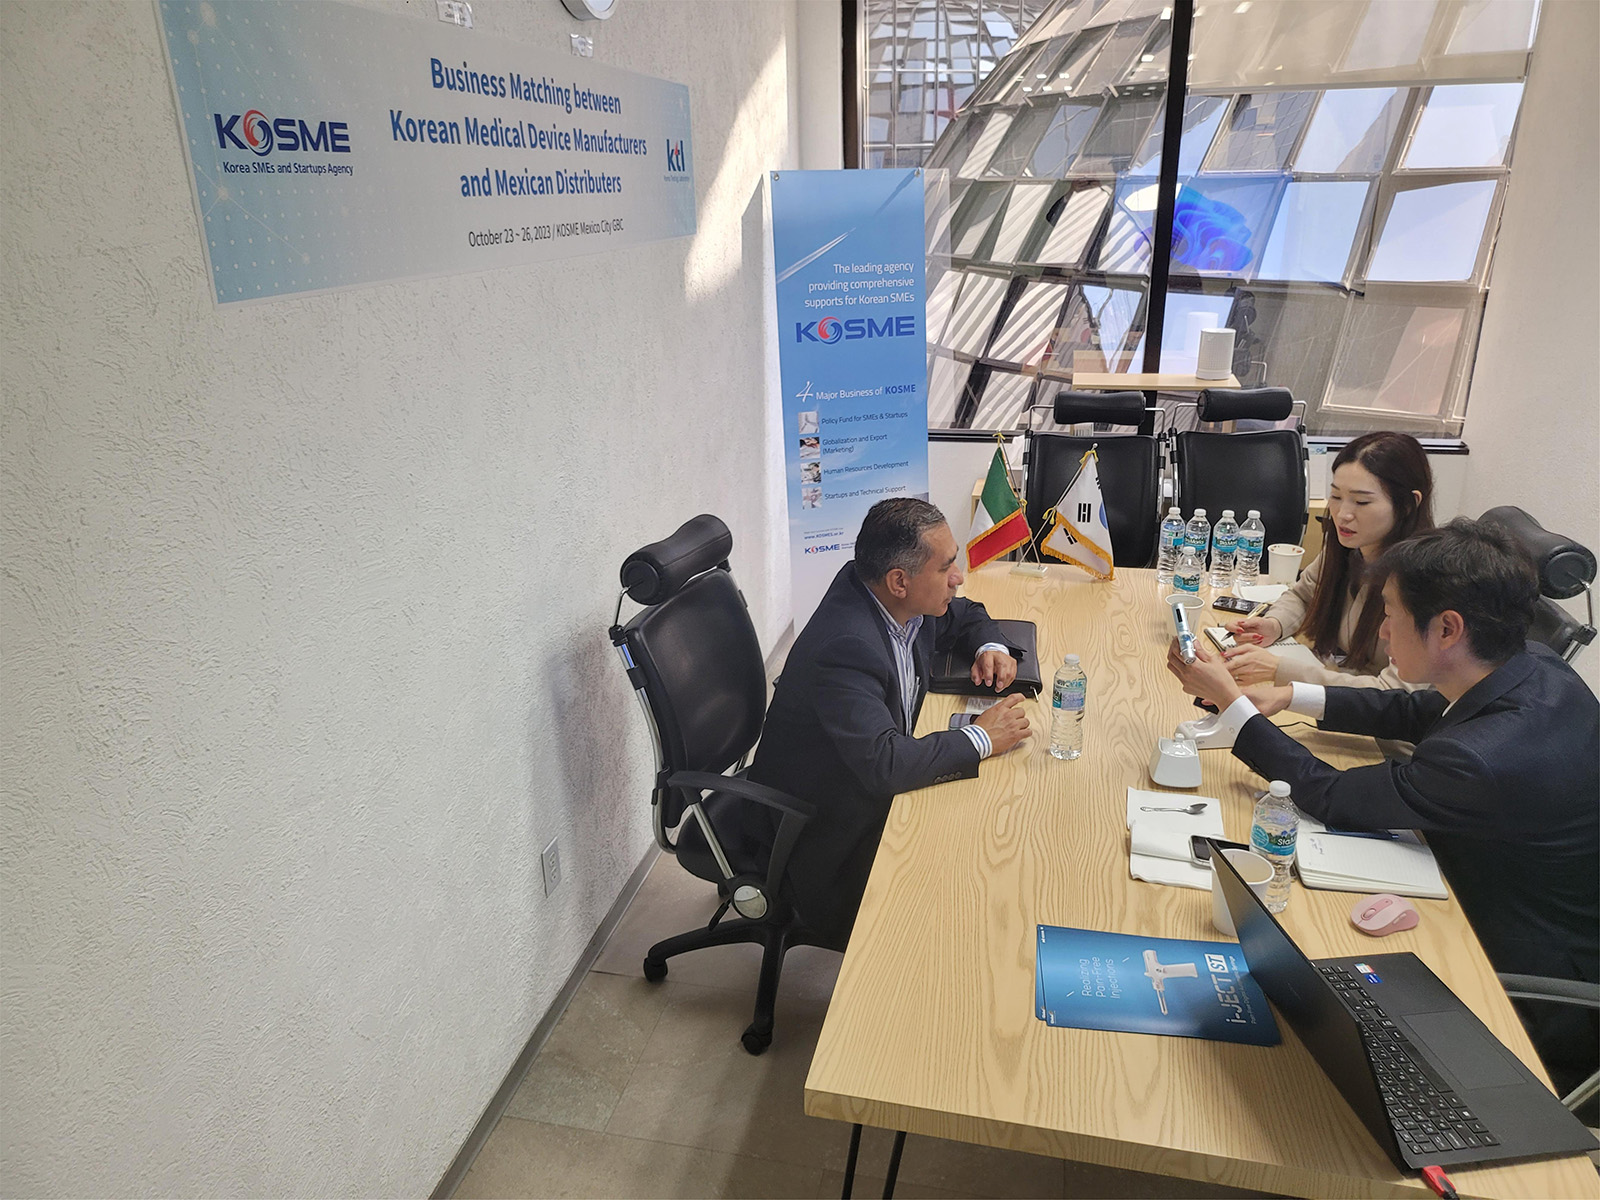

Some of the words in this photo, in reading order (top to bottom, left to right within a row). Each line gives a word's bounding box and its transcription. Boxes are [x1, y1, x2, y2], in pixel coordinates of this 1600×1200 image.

[430, 57, 507, 99] Business
[509, 72, 573, 114] Matching
[573, 82, 622, 115] between
[213, 109, 352, 157] KOSME
[389, 109, 462, 145] Korean
[464, 116, 527, 149] Medical
[527, 122, 571, 151] Device
[573, 127, 648, 156] Manufacturers
[666, 138, 686, 172] ktl
[222, 161, 250, 174] Korea
[253, 162, 275, 174] SMEs
[277, 162, 292, 174] and
[294, 162, 326, 176] Startups
[327, 163, 354, 176] Agency
[460, 167, 492, 198] and
[494, 167, 554, 197] Mexican
[555, 168, 623, 195] Distributers
[468, 229, 503, 247] October
[504, 228, 515, 244] 23
[521, 227, 534, 243] 26,
[534, 225, 551, 241] 2023
[551, 223, 556, 241] /
[556, 221, 579, 238] KOSME
[580, 220, 601, 235] Mexico
[601, 219, 612, 236] City
[833, 263, 850, 274] The
[851, 262, 883, 275] leading
[883, 262, 915, 275] agency
[808, 280, 849, 293] providing
[849, 277, 915, 290] comprehensive
[804, 296, 844, 309] supports
[844, 294, 857, 305] for
[858, 294, 889, 305] Korean
[889, 292, 915, 303] SMEs
[795, 315, 915, 345] KOSME
[795, 380, 814, 403] 4
[816, 390, 838, 401] Major
[839, 388, 874, 399] Business
[874, 386, 883, 396] of
[885, 384, 916, 395] KOSME
[862, 413, 879, 421] SMEs
[884, 411, 908, 419] Startups
[822, 436, 858, 446] Globalization
[870, 434, 888, 442] Export
[822, 446, 855, 455] (Marketing)
[845, 465, 873, 473] Resources
[873, 461, 909, 470] Development
[824, 492, 848, 500] Startups
[860, 487, 885, 496] Technical
[884, 485, 906, 493] Support
[804, 544, 840, 554] KOSME
[1207, 955, 1226, 972] ST
[1079, 958, 1093, 997] Realizing
[1091, 956, 1106, 998] Pain-Free
[1105, 958, 1122, 999] Injections
